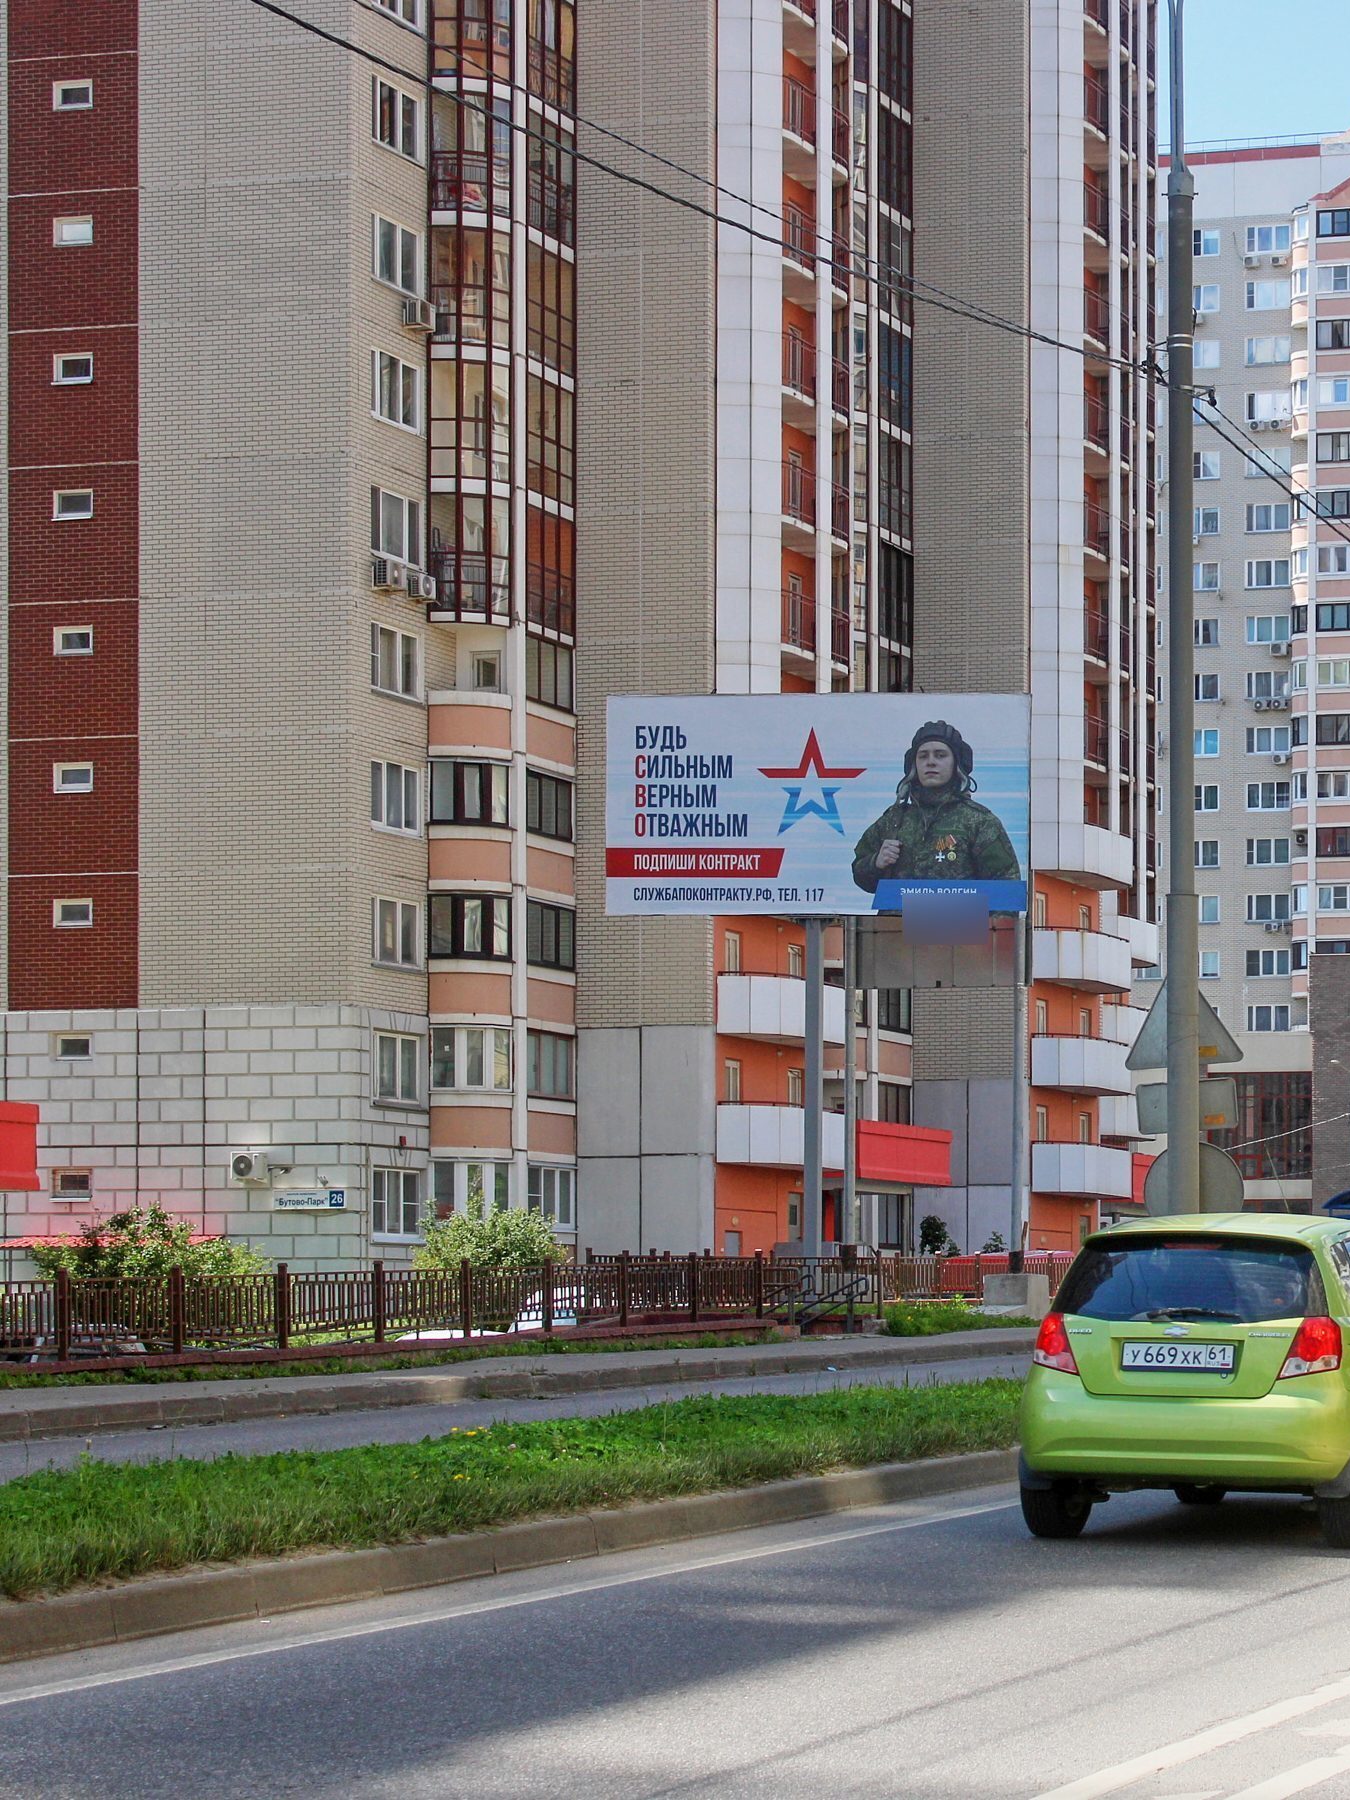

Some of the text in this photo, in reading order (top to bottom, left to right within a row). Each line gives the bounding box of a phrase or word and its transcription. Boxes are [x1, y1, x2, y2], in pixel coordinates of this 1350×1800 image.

[635, 725, 687, 752] БУДЬ
[635, 754, 733, 779] СИЛЬНЫМ
[634, 784, 717, 808] ВЕРНЫМ
[634, 813, 748, 838] ОТВАЖНЫМ
[633, 854, 761, 872] ПОДПИШИ КОНТРАКТ
[633, 887, 824, 903] СЛУЖБАПОКОНТРАКТУ.РФ, ТЕЛ. 117
[331, 1193, 343, 1204] 26
[1208, 1346, 1226, 1361] 61
